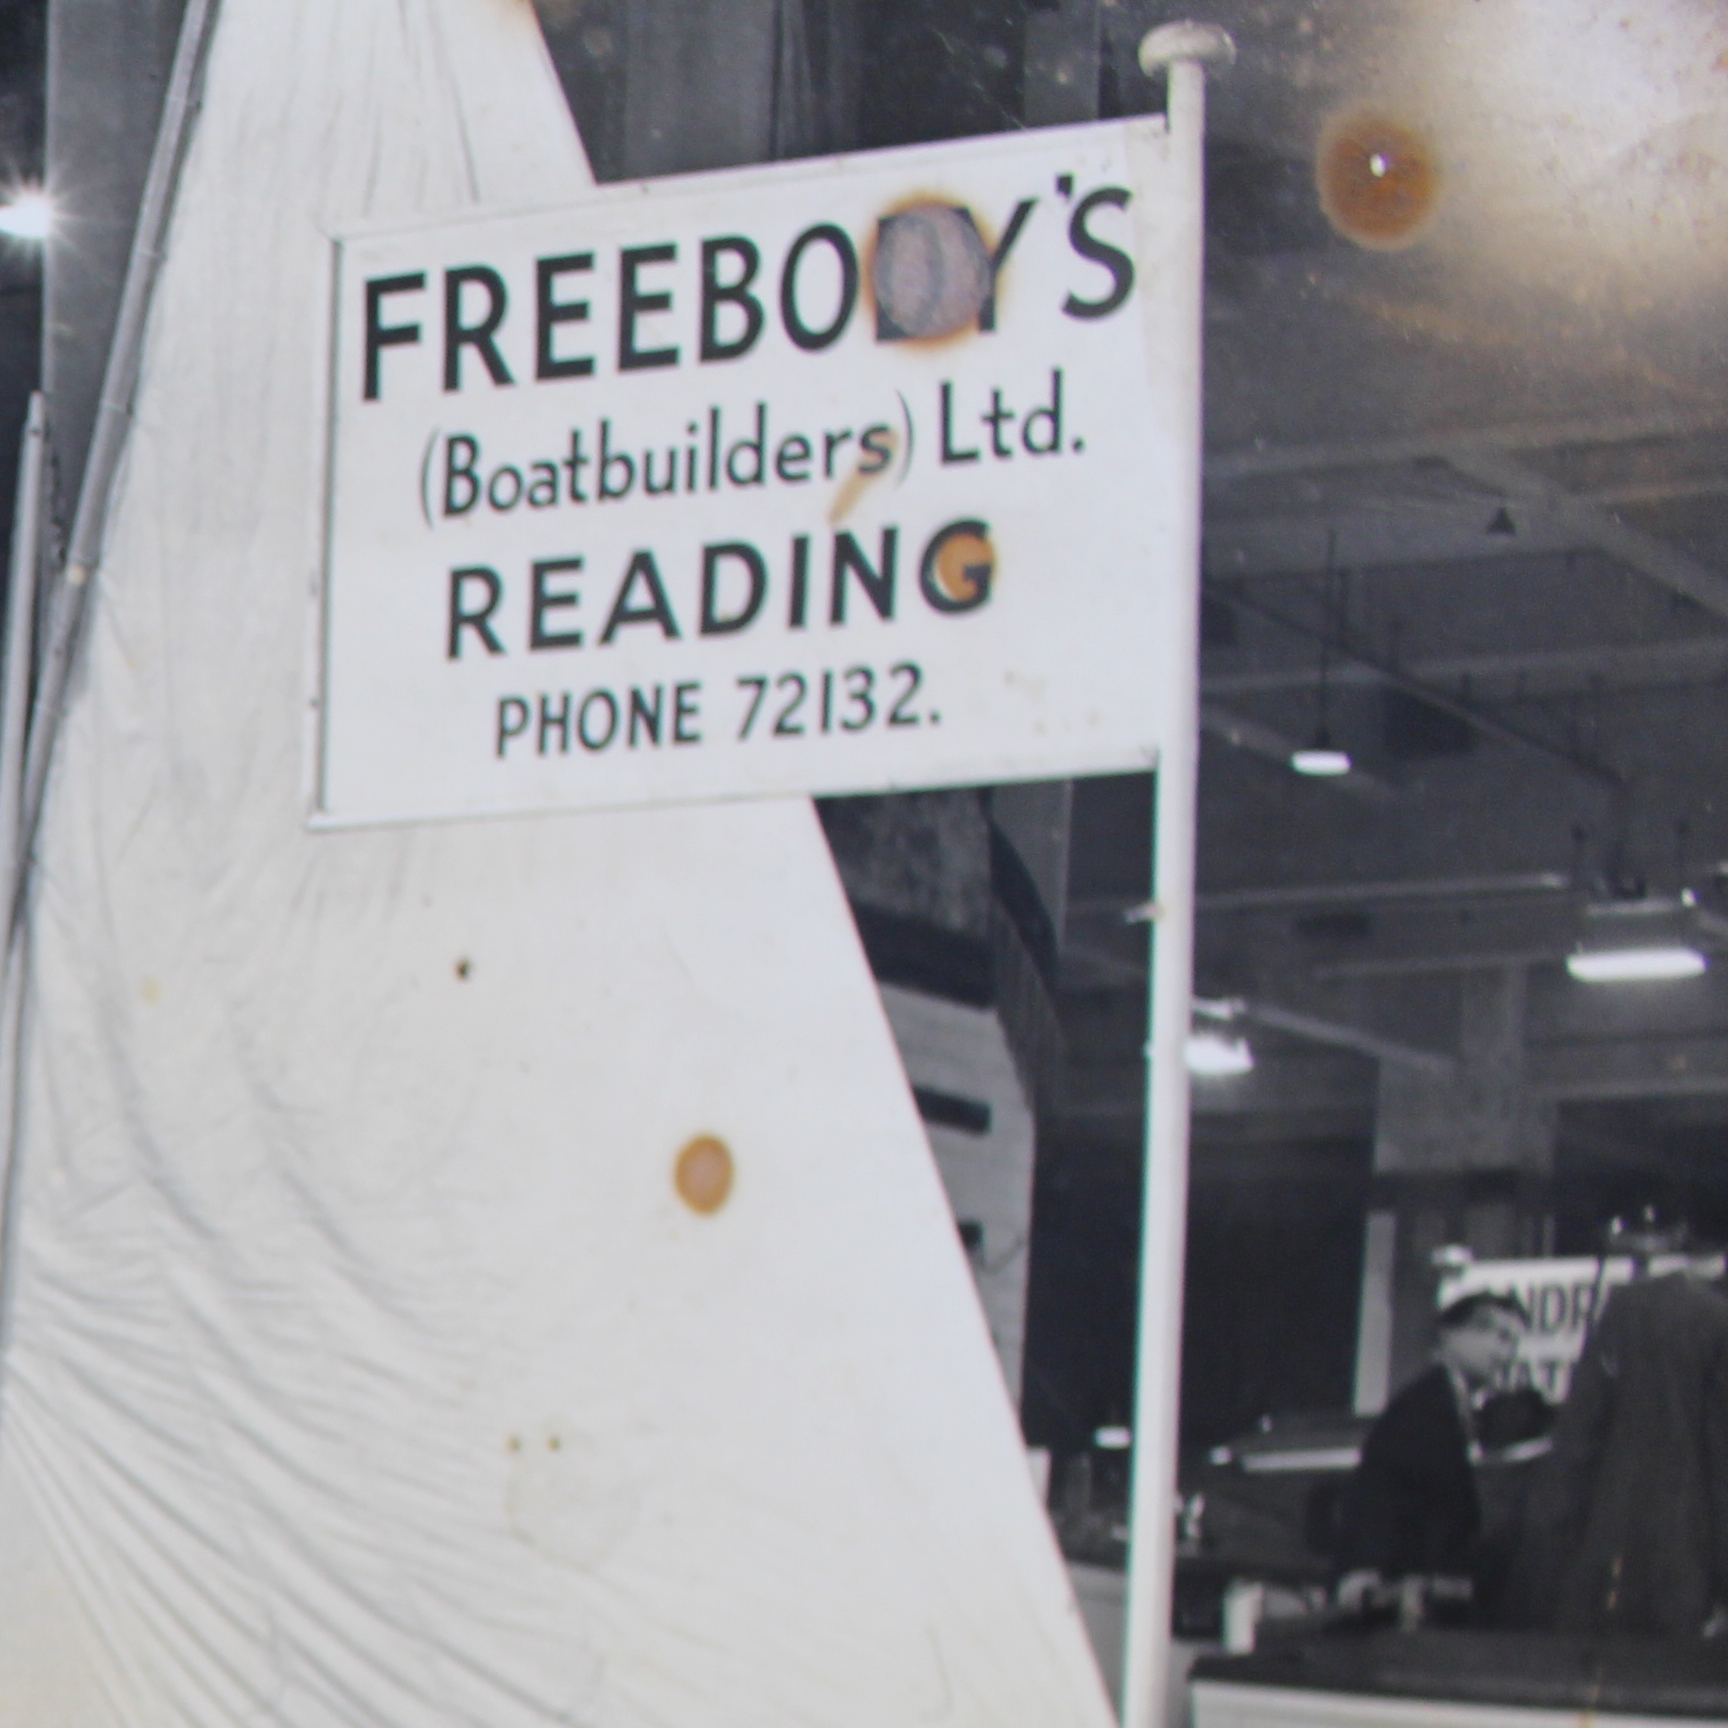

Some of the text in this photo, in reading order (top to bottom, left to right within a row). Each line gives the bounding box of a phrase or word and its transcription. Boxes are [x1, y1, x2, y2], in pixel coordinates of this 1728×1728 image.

[358, 172, 1138, 404] FREEBODY'S
[418, 367, 1086, 529] (Boatbuilders) Ltd.
[446, 516, 997, 662] READING
[495, 661, 942, 760] PHONE 72132.
